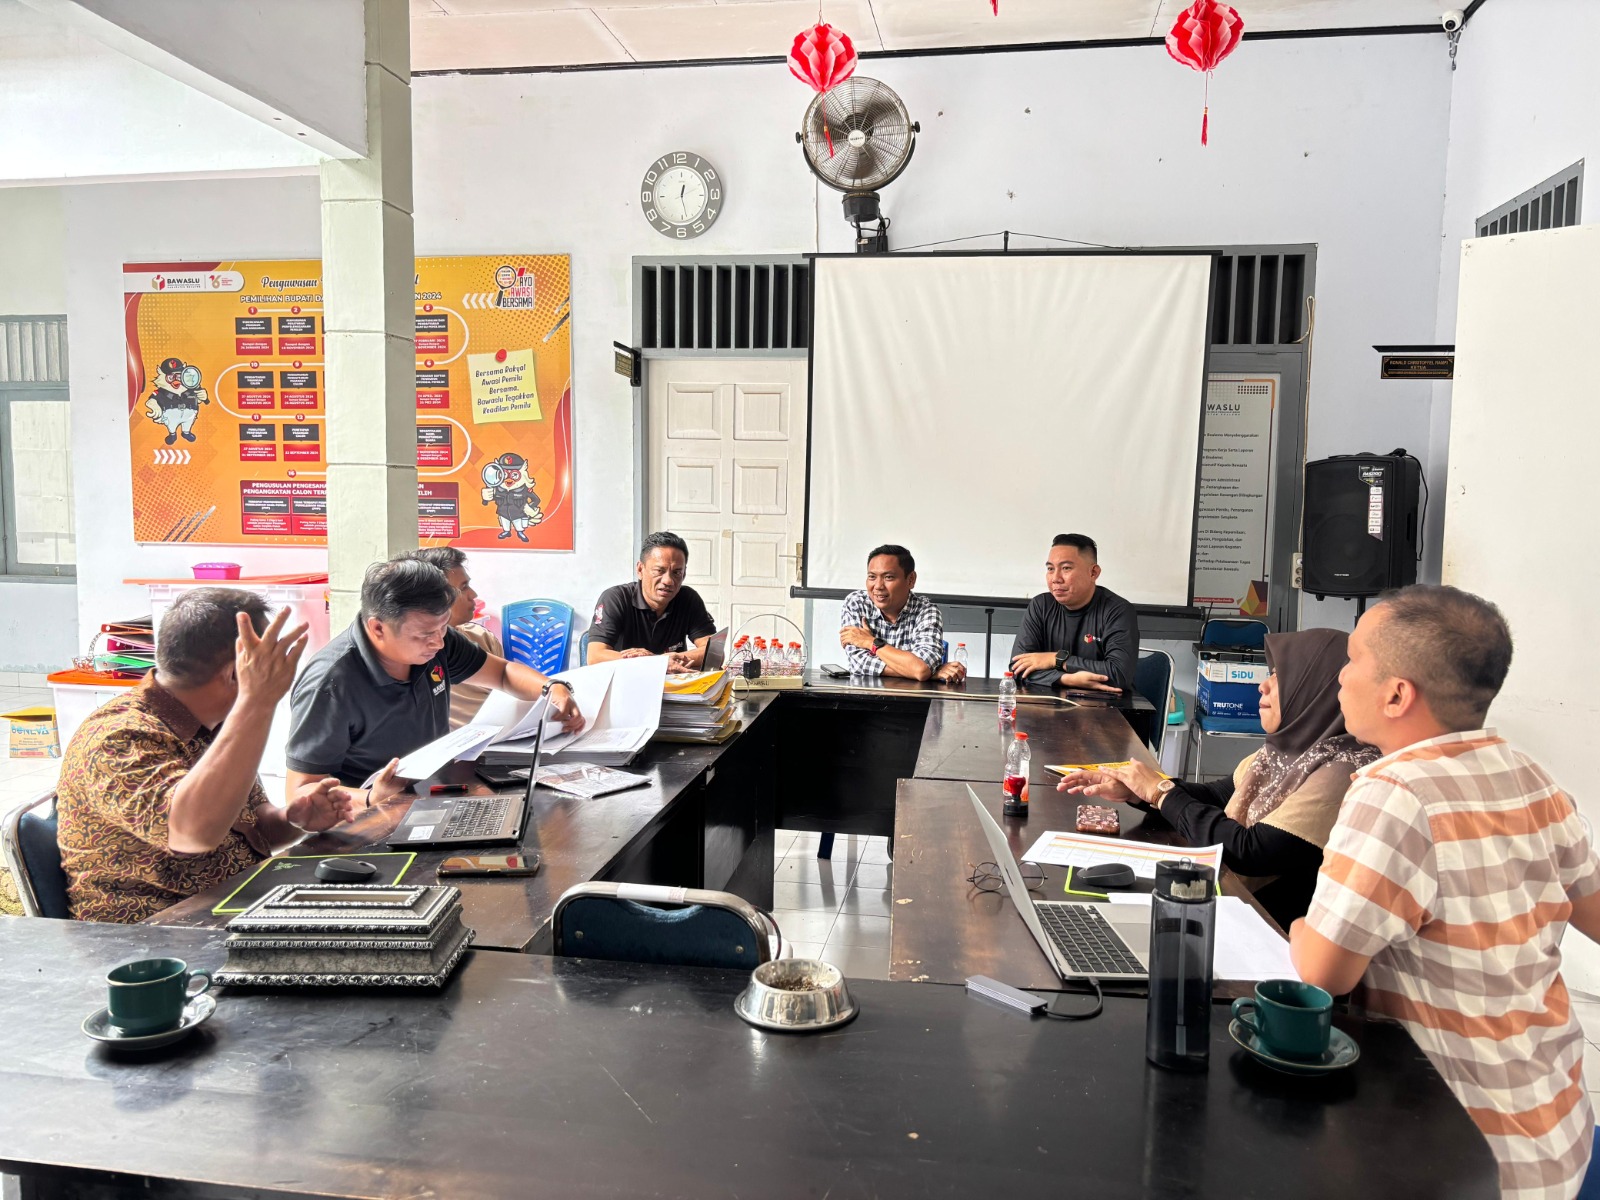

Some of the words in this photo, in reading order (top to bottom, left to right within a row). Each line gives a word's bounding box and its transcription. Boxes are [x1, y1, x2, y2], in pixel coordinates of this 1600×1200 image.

[658, 158, 668, 170] 11
[673, 153, 687, 164] 12
[695, 158, 700, 167] 1
[645, 171, 657, 185] 10
[704, 169, 715, 182] 2
[642, 191, 651, 202] 9
[711, 189, 719, 200] 3
[646, 209, 657, 221] 8
[708, 208, 716, 219] 4
[661, 222, 671, 232] 7
[677, 228, 686, 237] 6
[693, 221, 704, 233] 5
[262, 276, 317, 291] Pengawasan
[520, 277, 532, 286] AYO
[511, 288, 532, 297] AWASI
[240, 295, 282, 303] PEMILIHAN
[285, 294, 312, 303] BUPATI
[502, 298, 532, 307] BERSAMA
[476, 369, 503, 377] Bersama
[505, 364, 526, 373] Rakyat
[482, 377, 500, 386] Awasi
[502, 375, 522, 383] Pemilu
[478, 396, 503, 405] Bawaslu
[505, 393, 534, 403] Tegakkan
[483, 405, 509, 414] Keadilan
[511, 402, 531, 410] Pemilu
[1232, 671, 1254, 679] SiDU
